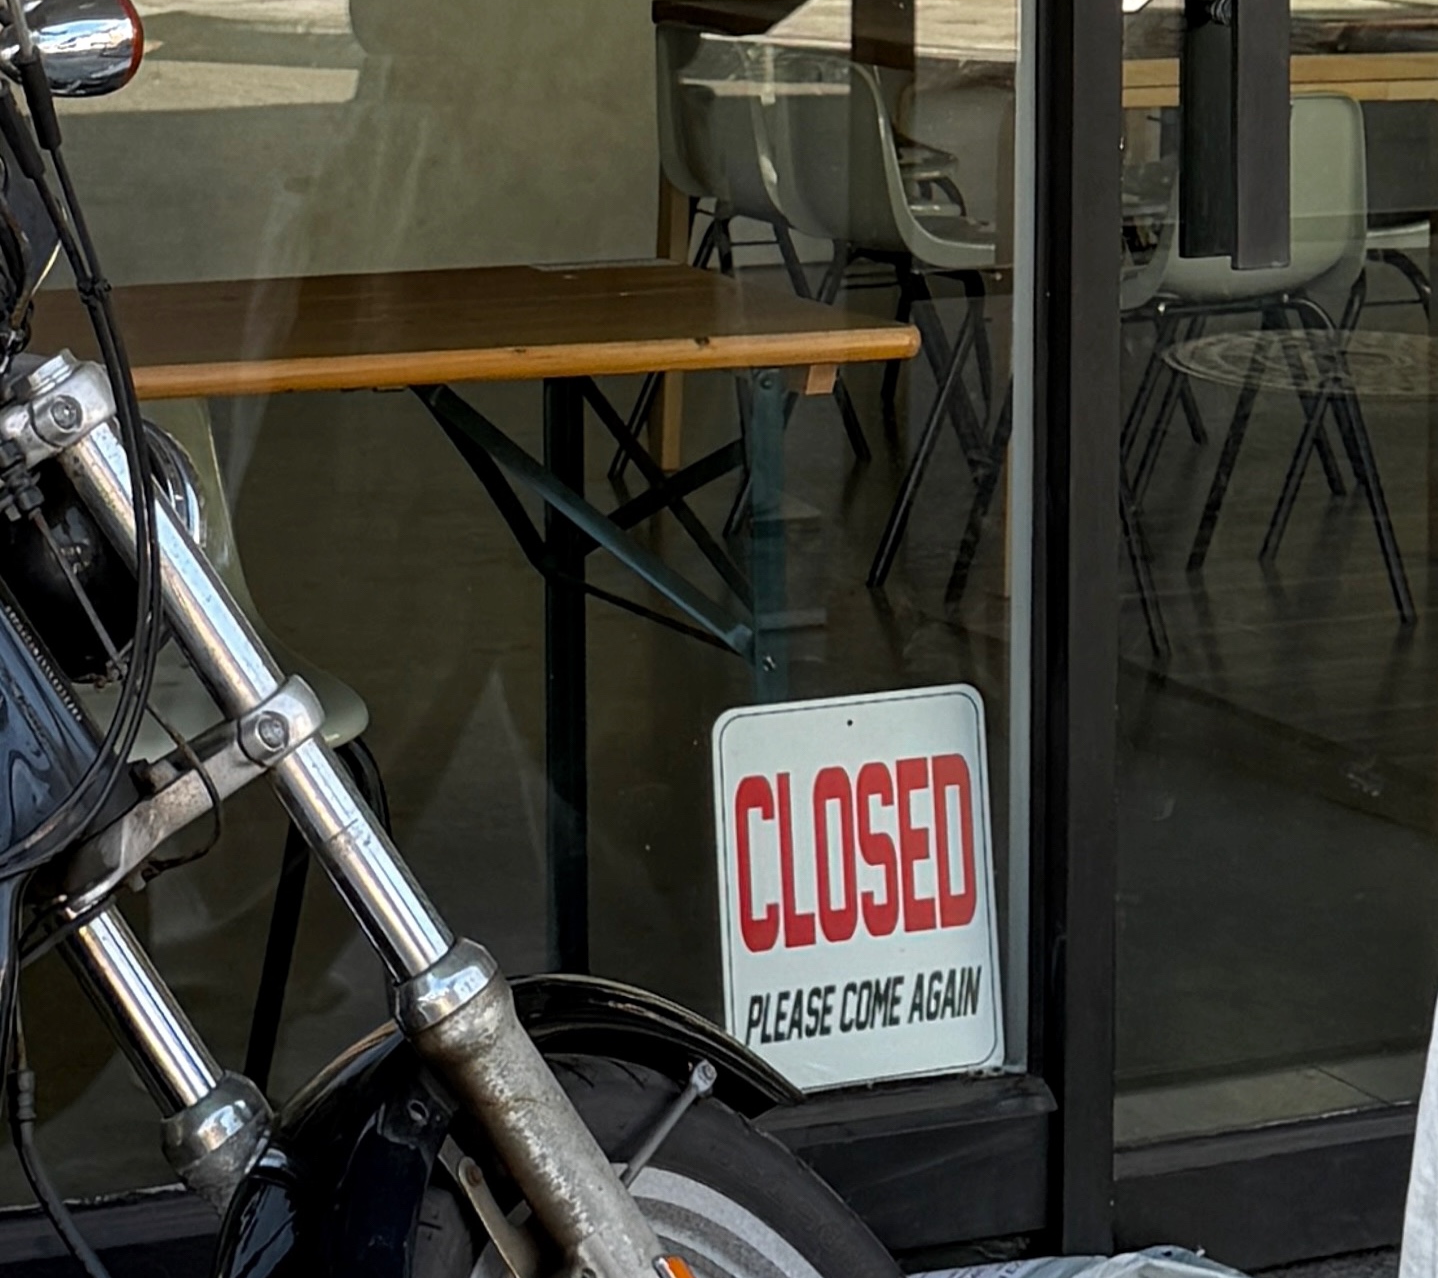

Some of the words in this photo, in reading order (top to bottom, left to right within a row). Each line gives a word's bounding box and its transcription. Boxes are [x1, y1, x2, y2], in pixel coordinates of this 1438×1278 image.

[735, 753, 977, 953] CLOSED
[745, 984, 836, 1046] PLEASE
[839, 975, 905, 1034] COME
[907, 965, 982, 1024] AGAIN
